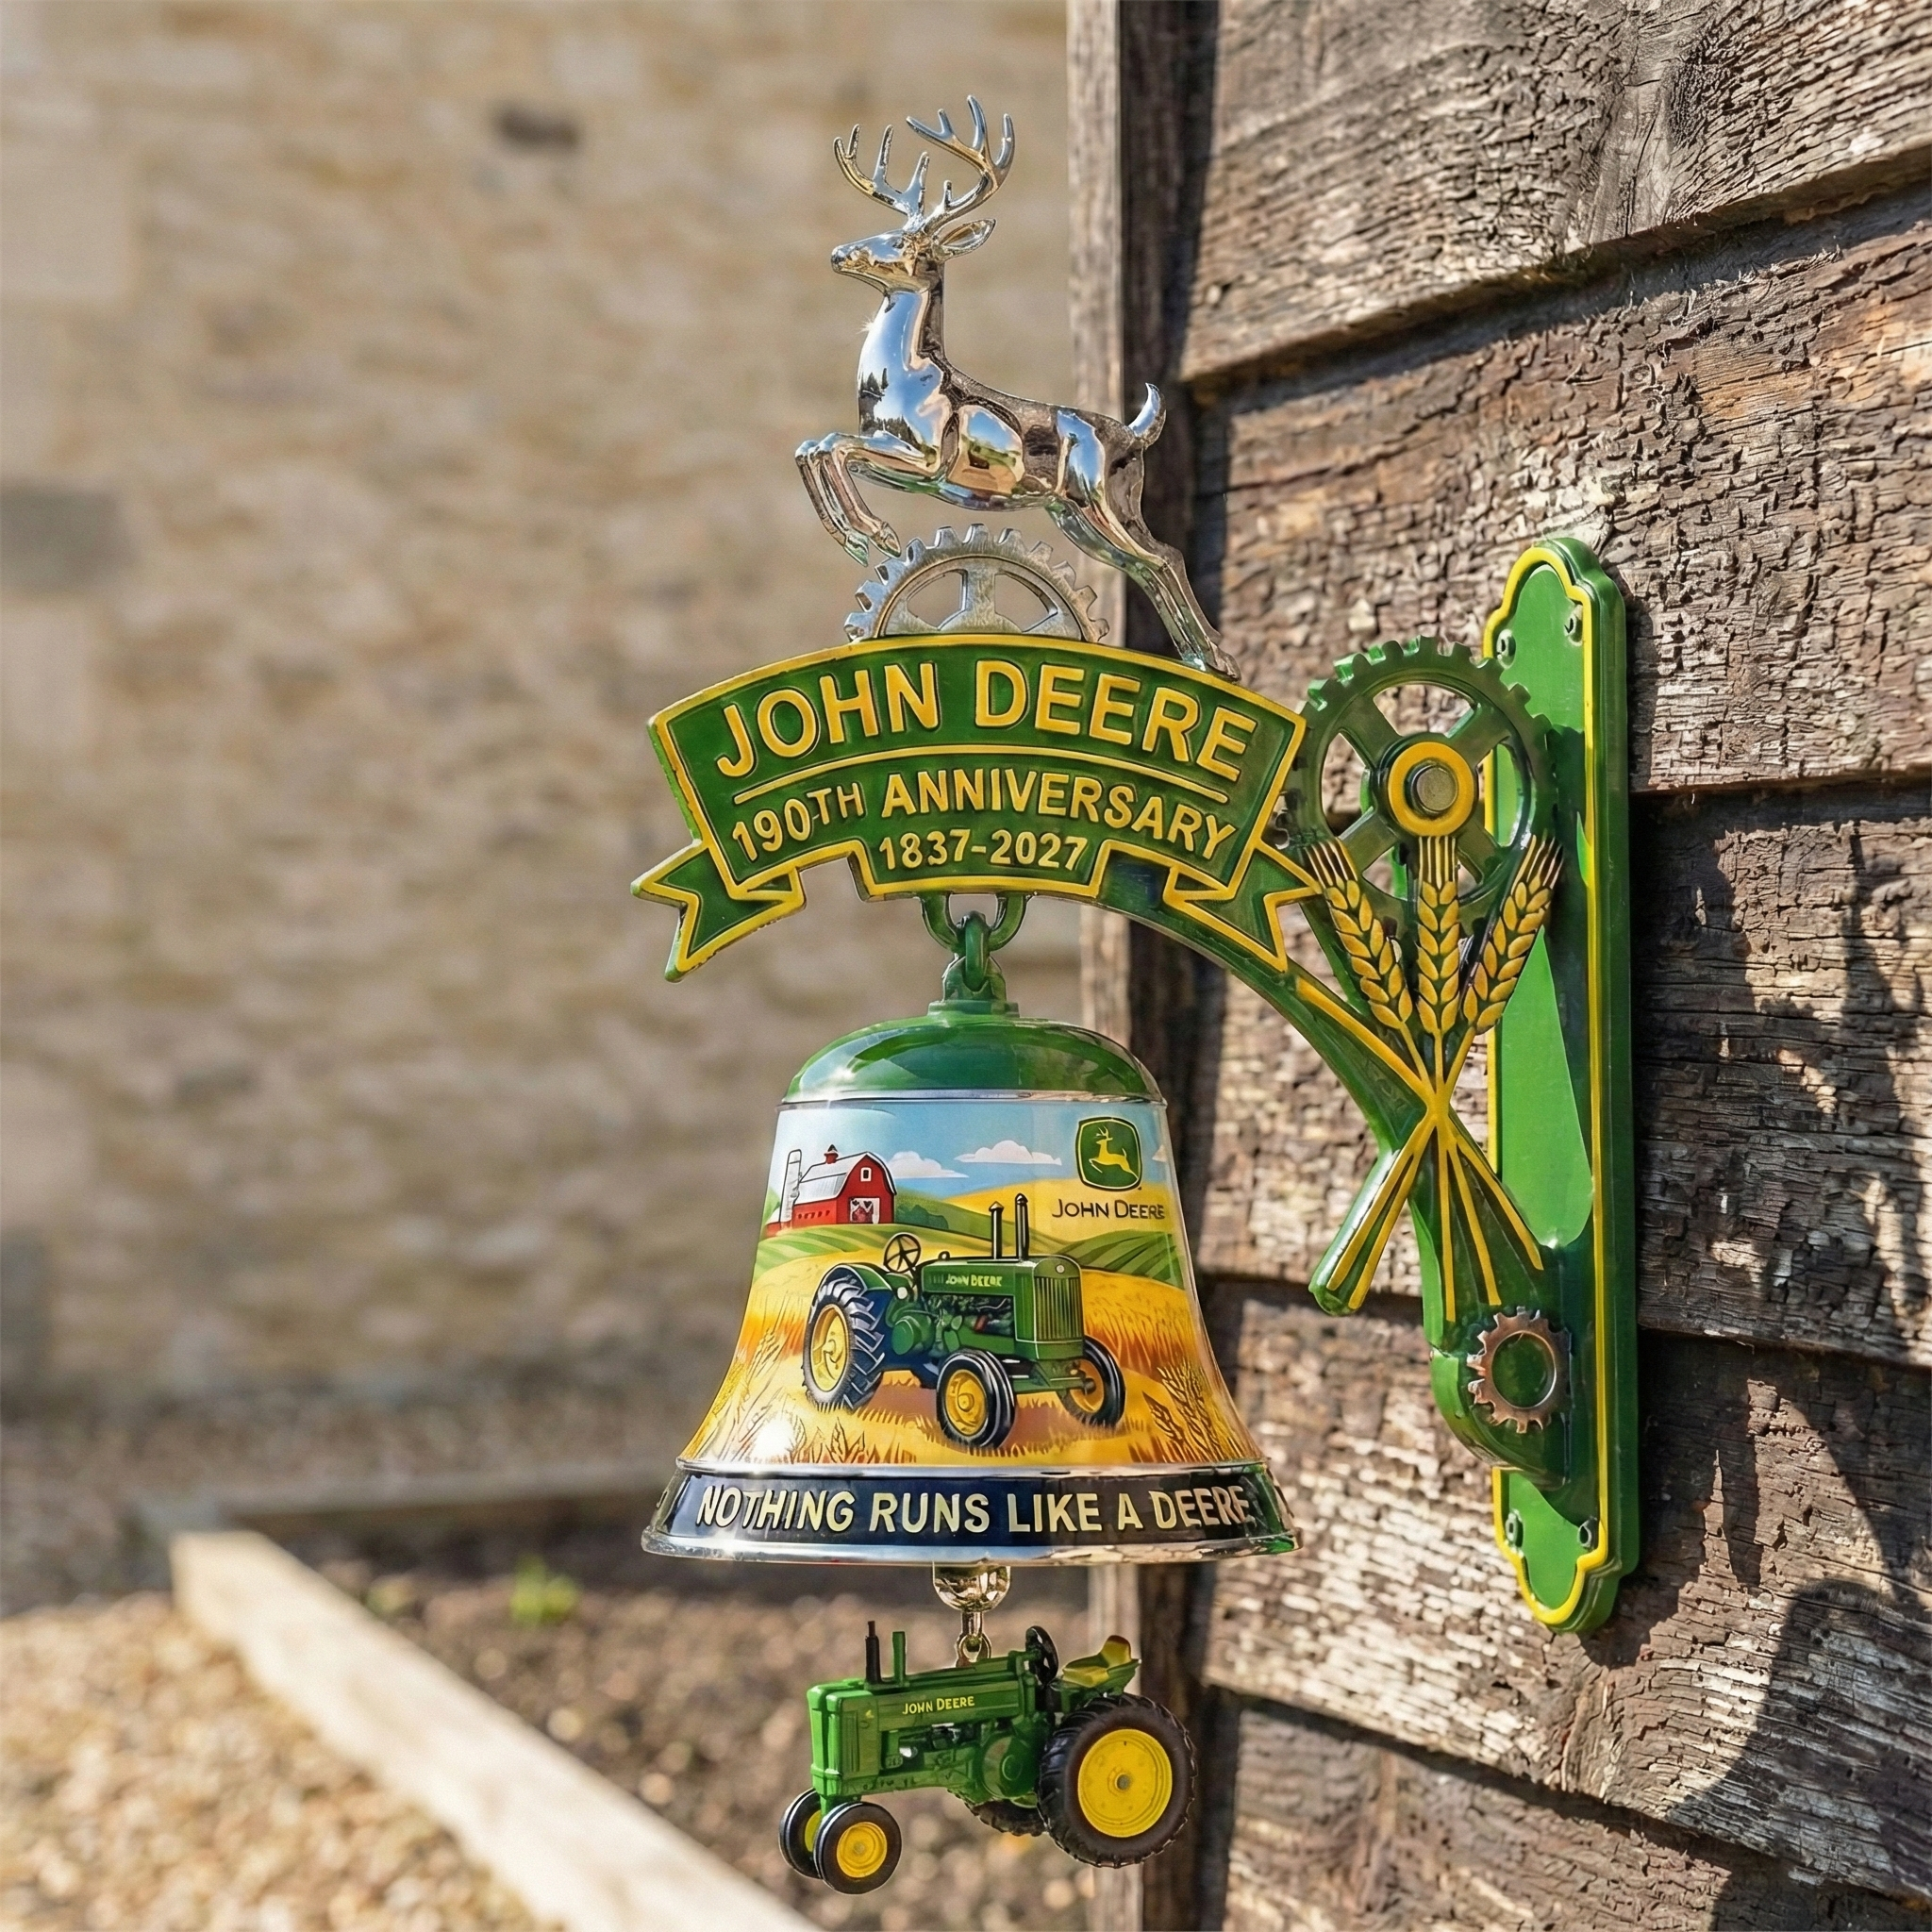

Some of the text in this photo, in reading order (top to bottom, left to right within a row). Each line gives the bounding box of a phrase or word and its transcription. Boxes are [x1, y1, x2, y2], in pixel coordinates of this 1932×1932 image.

[716, 660, 1256, 781] JOHN DEERE
[732, 769, 1236, 861] 190TH ANNIVERSARY
[878, 828, 1088, 871] 1837-2027
[1052, 1199, 1165, 1219] JOHN DEERE
[696, 1485, 855, 1532] NOTHING
[869, 1492, 991, 1534] RUNS
[1008, 1492, 1102, 1533] LIKE
[1118, 1492, 1143, 1530] A
[902, 1696, 974, 1714] JOHN DEERE
